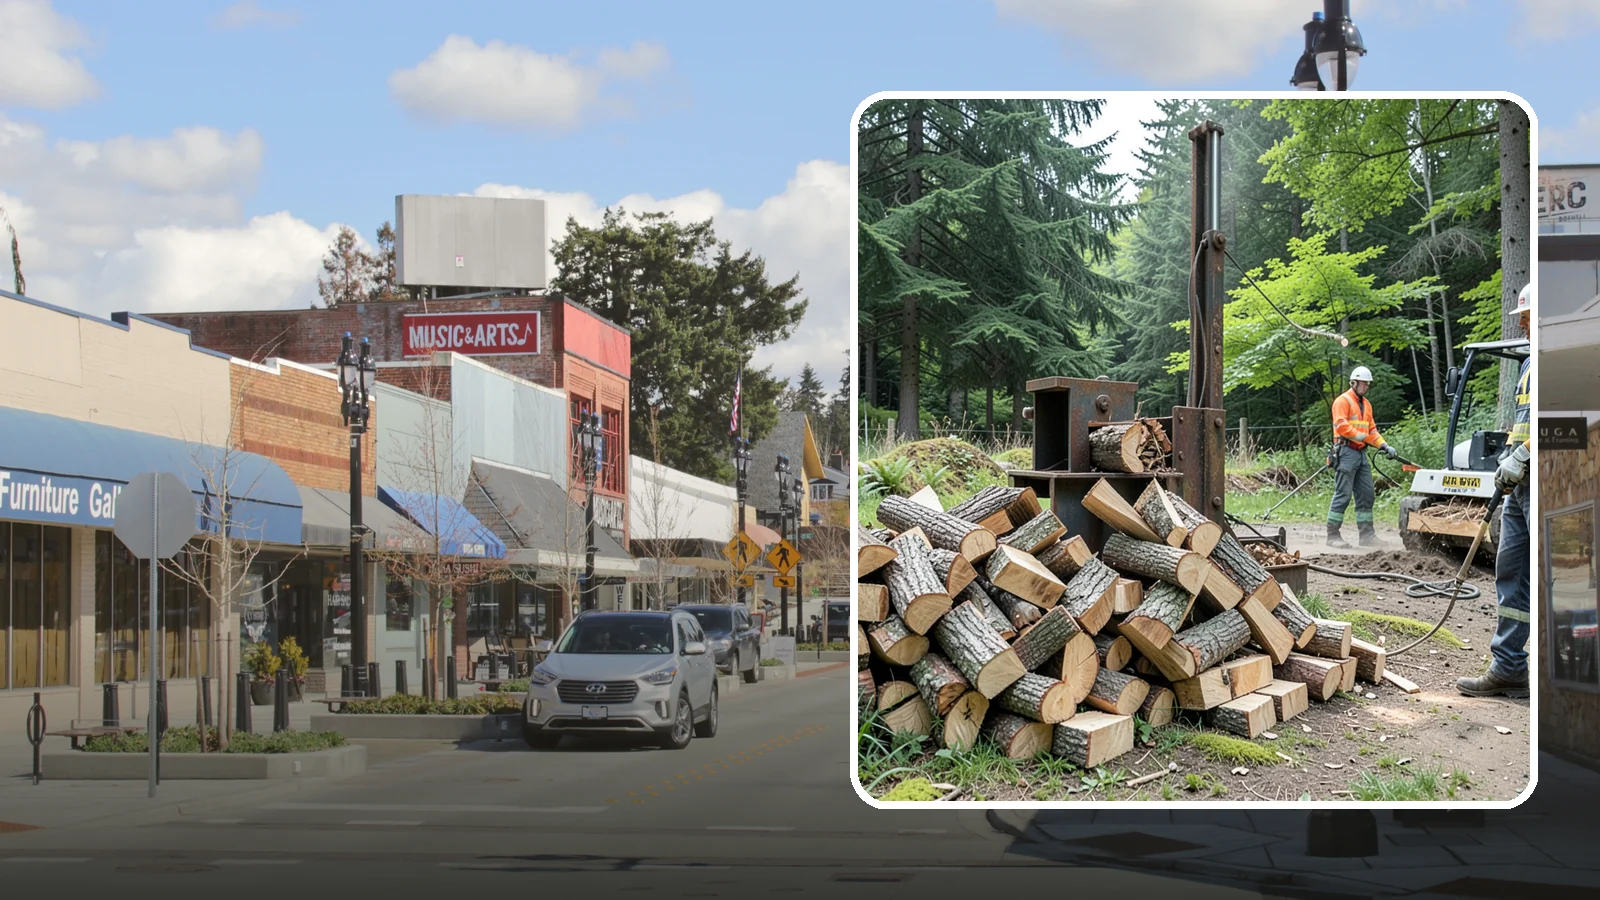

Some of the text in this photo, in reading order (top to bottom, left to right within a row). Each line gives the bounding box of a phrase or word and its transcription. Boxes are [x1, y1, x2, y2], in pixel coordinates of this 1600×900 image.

[409, 323, 520, 349] MUSIC&ARTS
[0, 472, 122, 519] Furniture Gal
[453, 563, 479, 574] SUSHI
